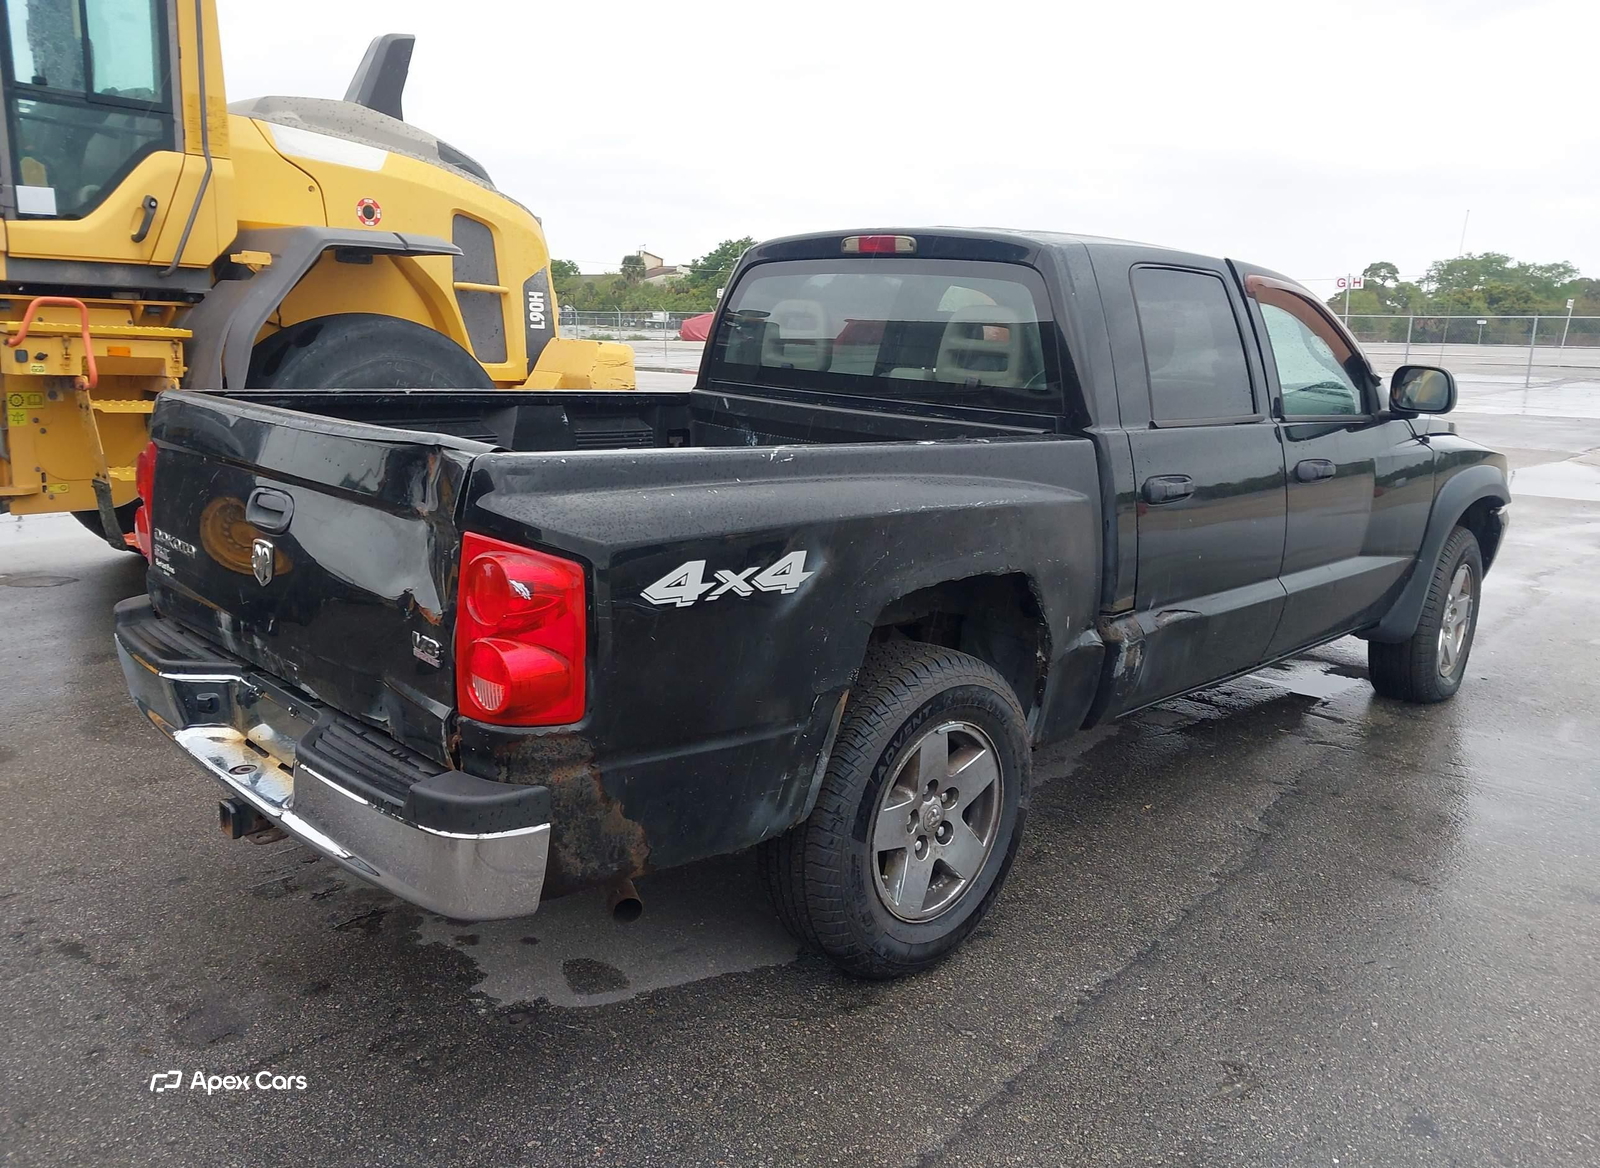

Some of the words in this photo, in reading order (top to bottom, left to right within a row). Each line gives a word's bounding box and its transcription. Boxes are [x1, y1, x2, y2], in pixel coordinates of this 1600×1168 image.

[1336, 277, 1347, 288] G
[1352, 277, 1362, 288] H
[528, 291, 546, 330] L90H
[639, 550, 816, 607] 4x4
